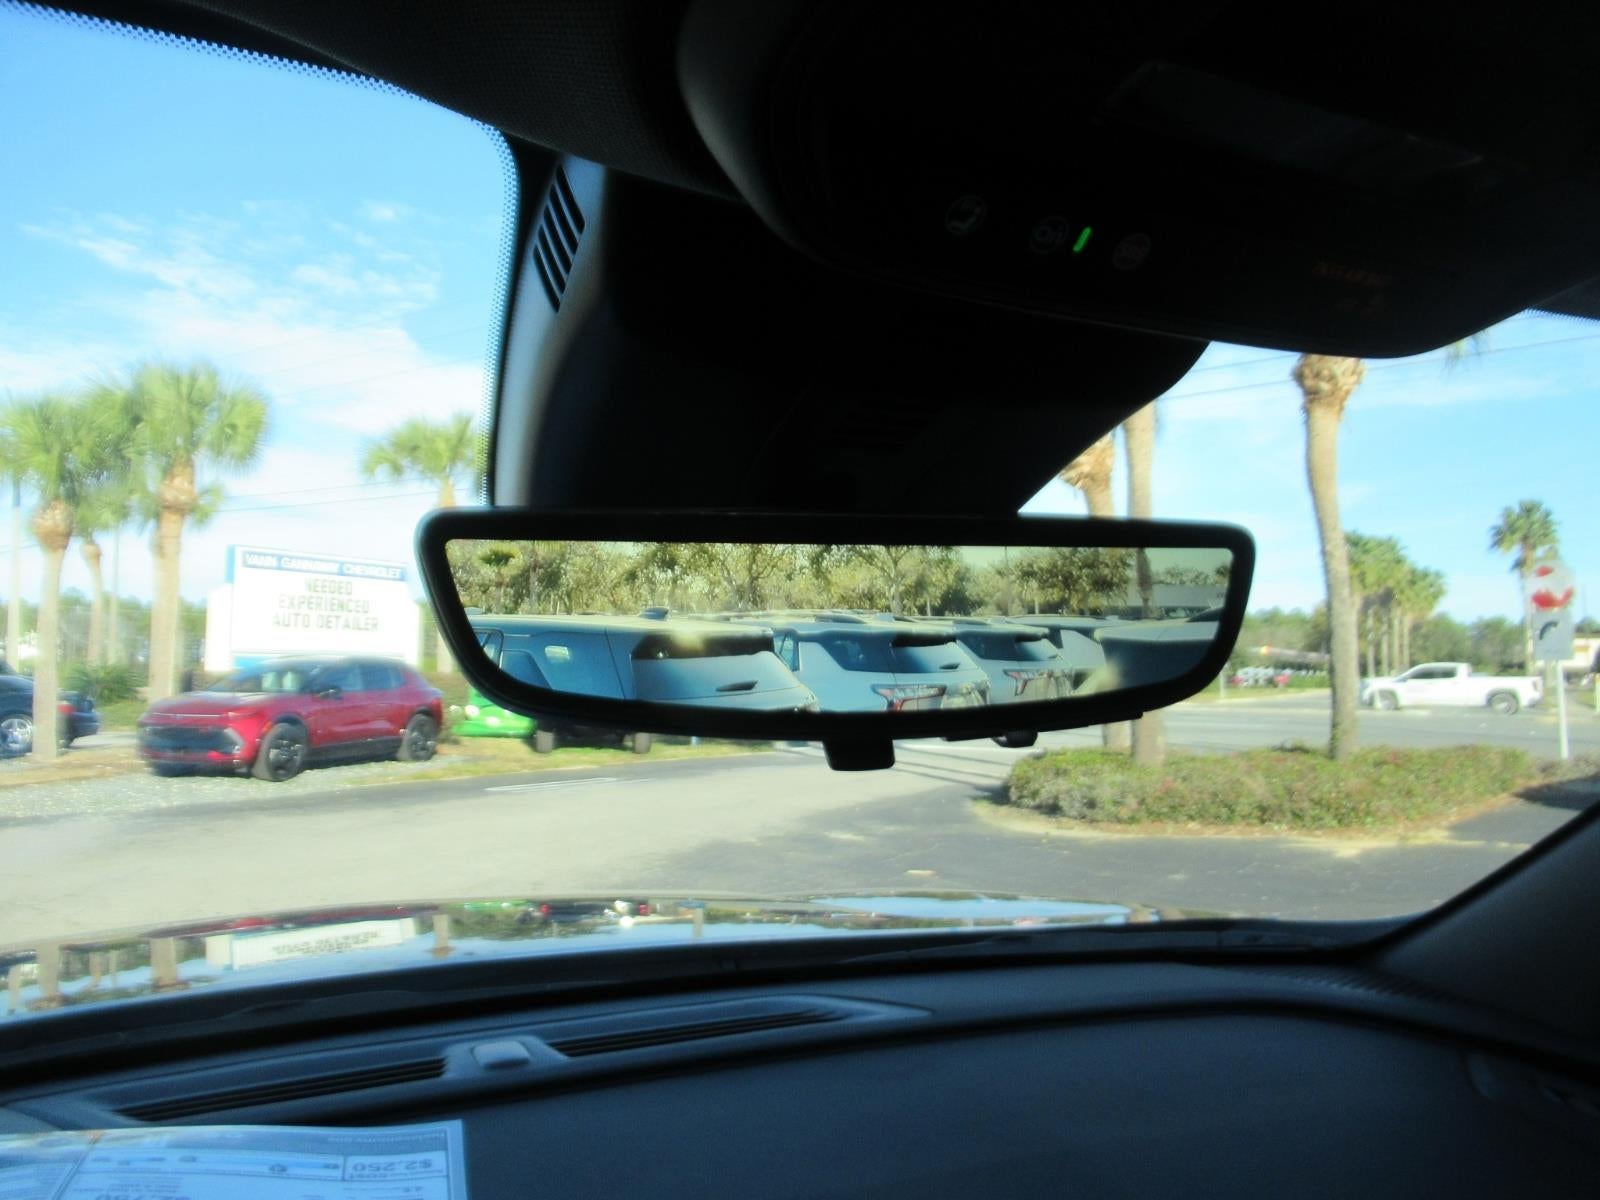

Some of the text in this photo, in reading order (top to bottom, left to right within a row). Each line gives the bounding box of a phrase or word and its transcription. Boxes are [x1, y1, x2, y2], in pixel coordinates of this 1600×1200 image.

[306, 579, 353, 595] NEEDED
[279, 594, 370, 613] EXPERIENCED
[272, 612, 379, 631] AUTO DETAILER
